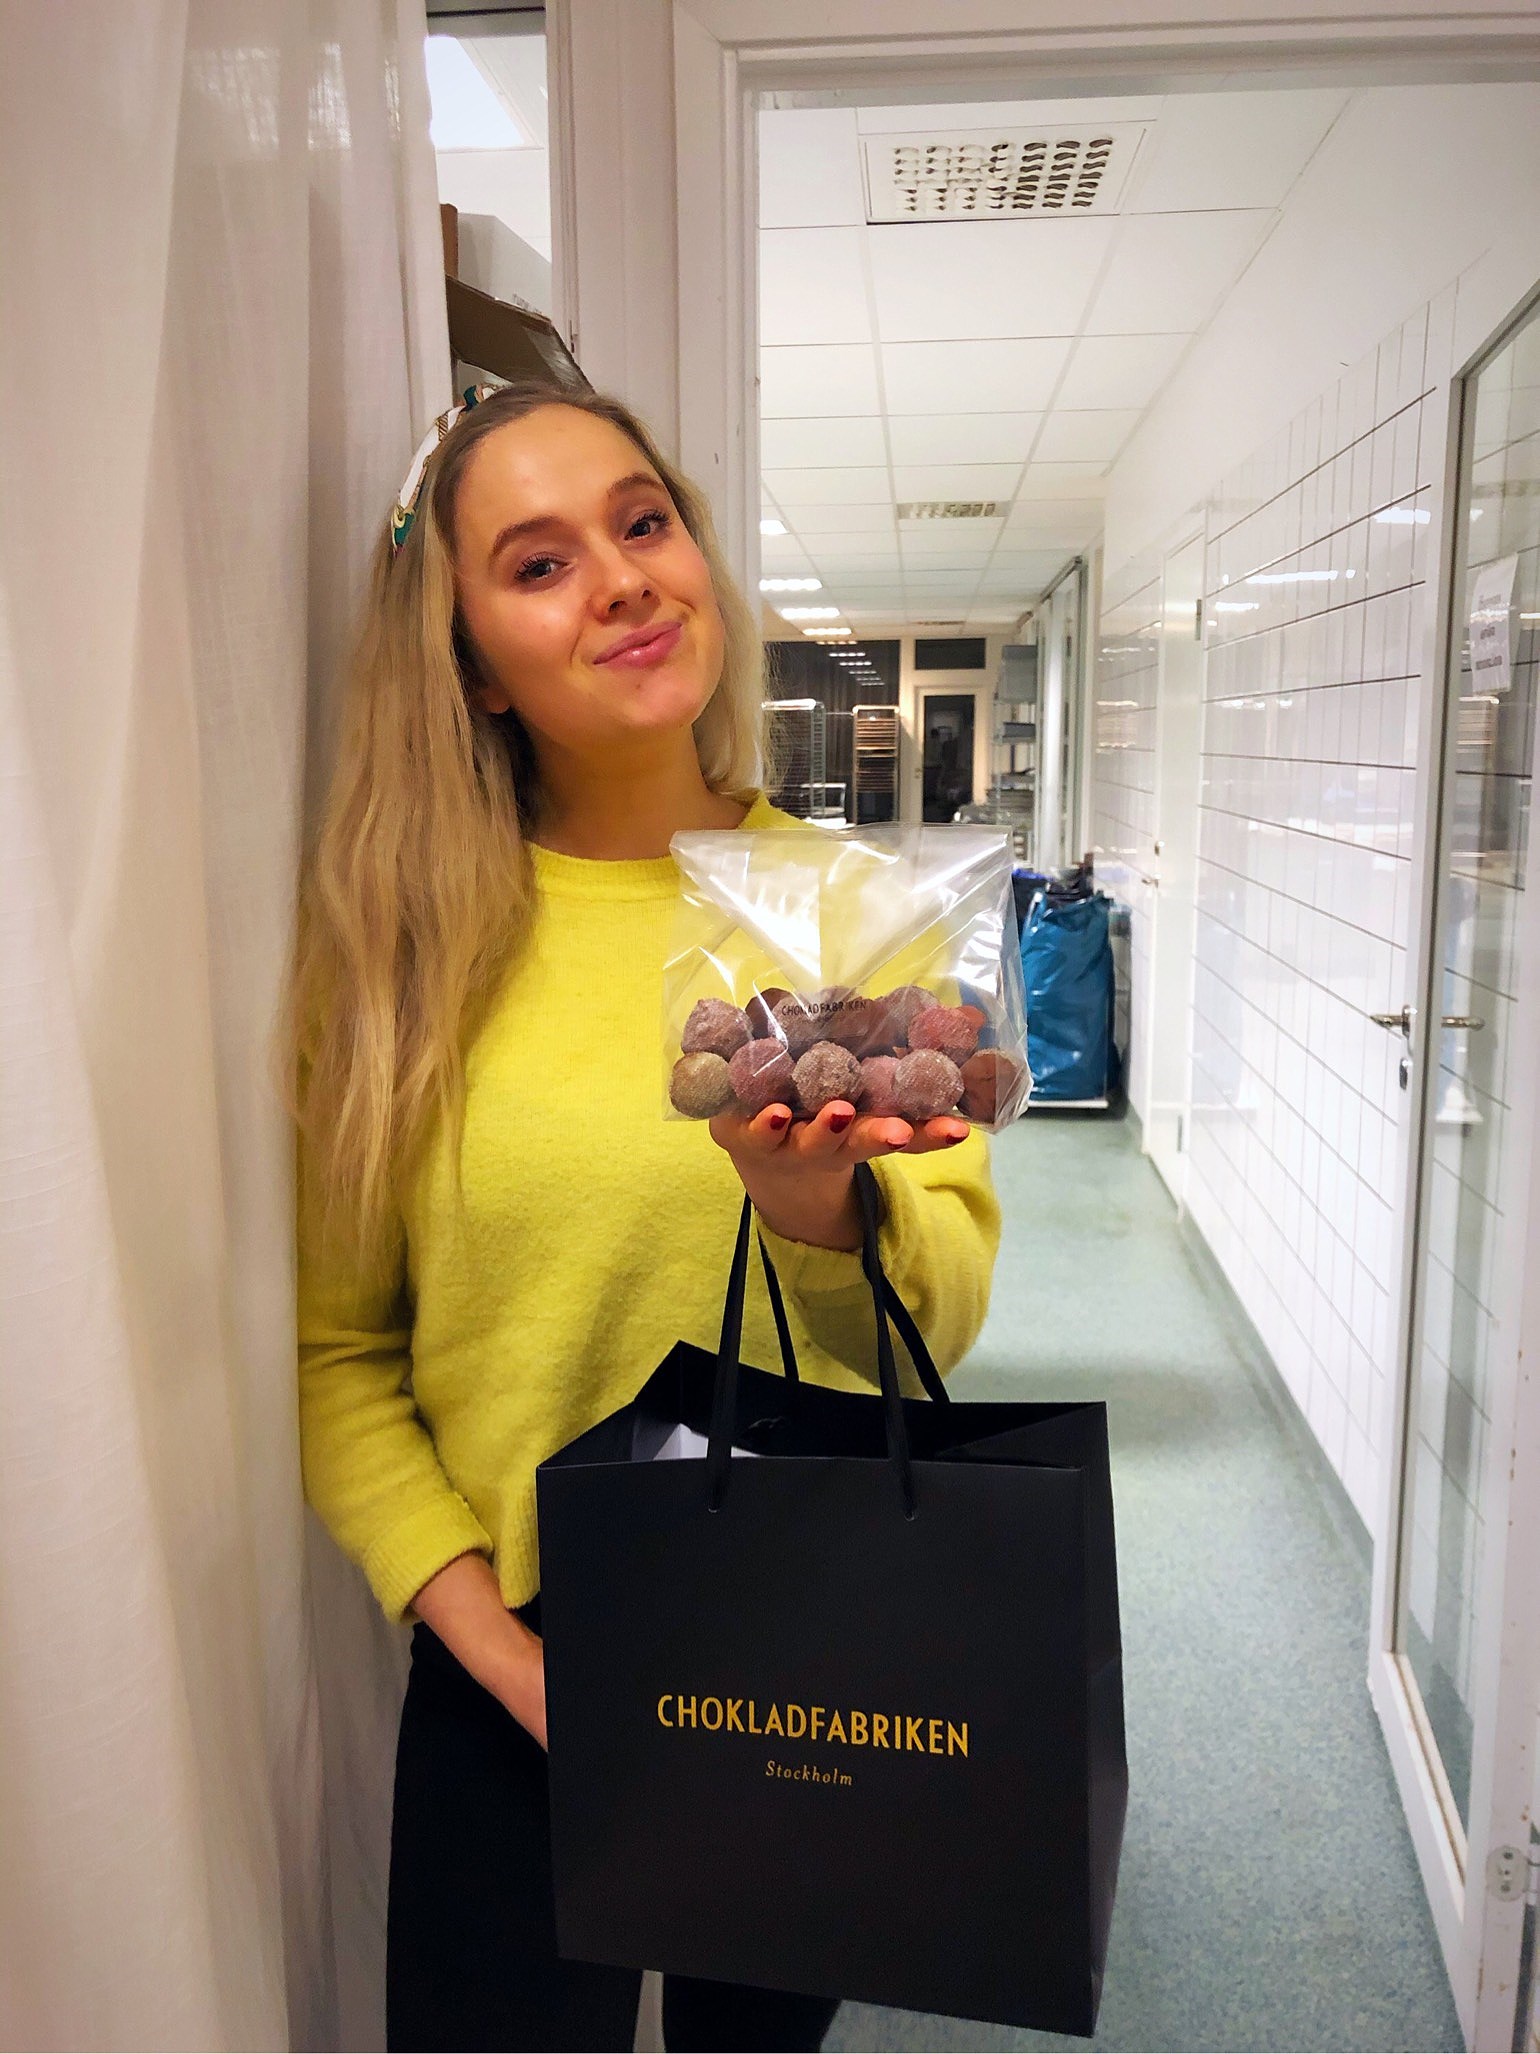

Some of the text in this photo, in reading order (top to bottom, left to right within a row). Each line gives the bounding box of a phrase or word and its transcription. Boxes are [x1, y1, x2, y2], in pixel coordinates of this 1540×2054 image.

[781, 1000, 866, 1016] CHOADFABRKEN
[657, 1695, 968, 1758] CHOKLADFABRIKEN
[765, 1760, 852, 1786] Stockholm
